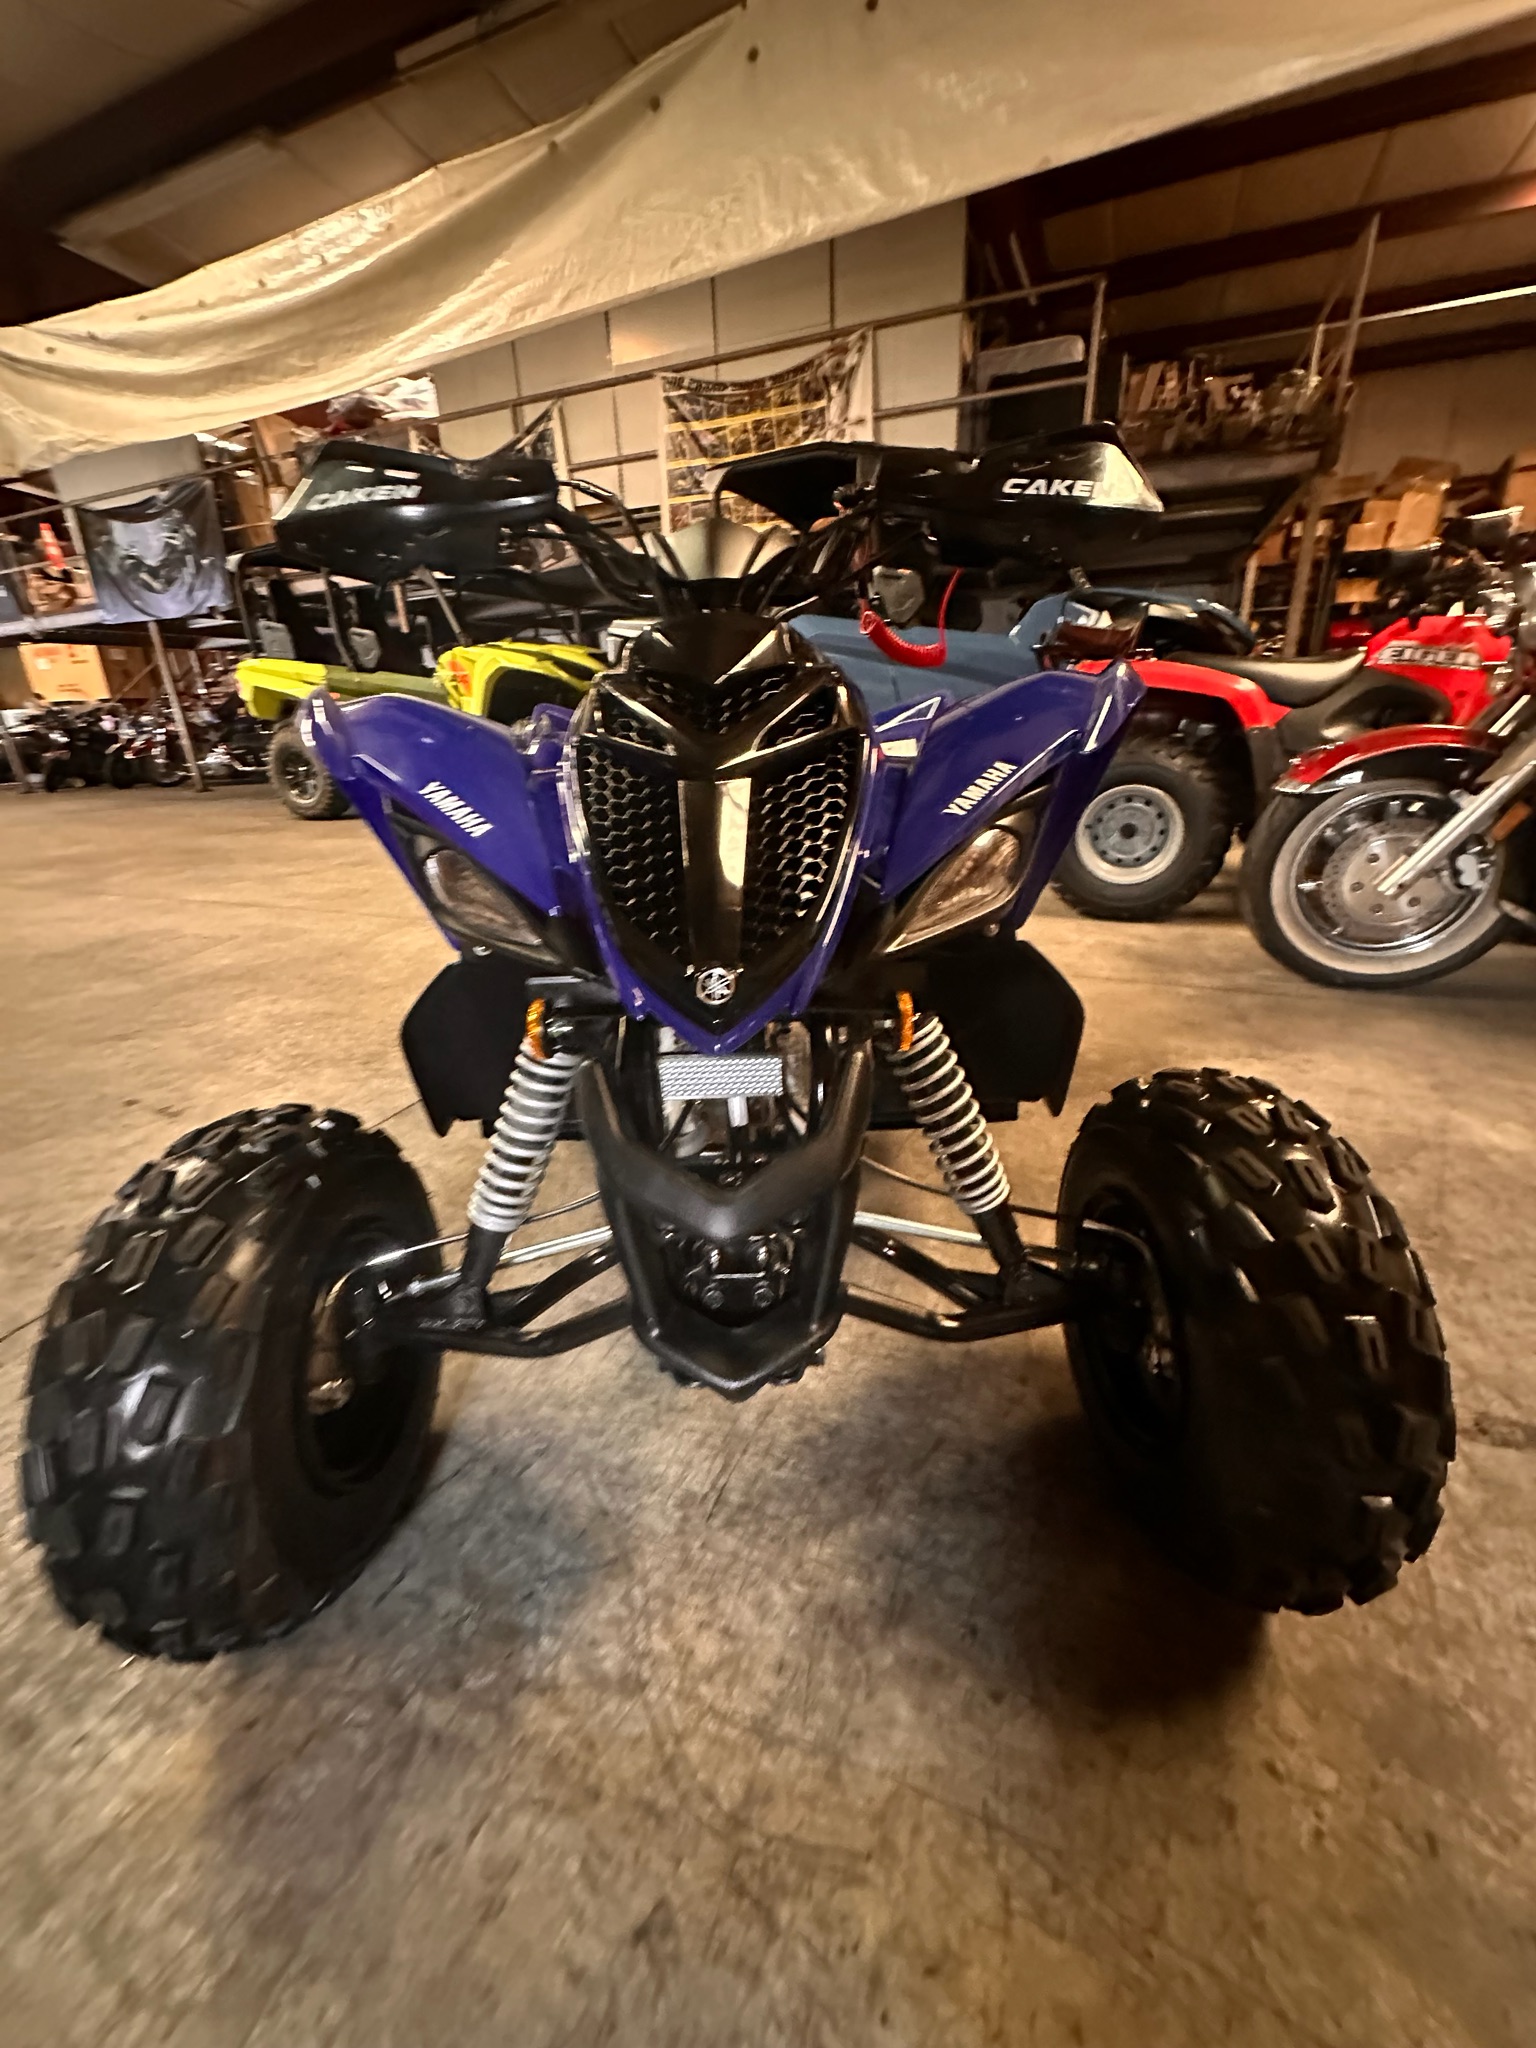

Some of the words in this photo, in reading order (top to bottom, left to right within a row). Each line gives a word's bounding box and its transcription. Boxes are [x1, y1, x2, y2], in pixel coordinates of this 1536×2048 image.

[1378, 646, 1480, 669] EIGER
[418, 781, 494, 837] YAMAHA
[940, 760, 1018, 816] YAMAHA
